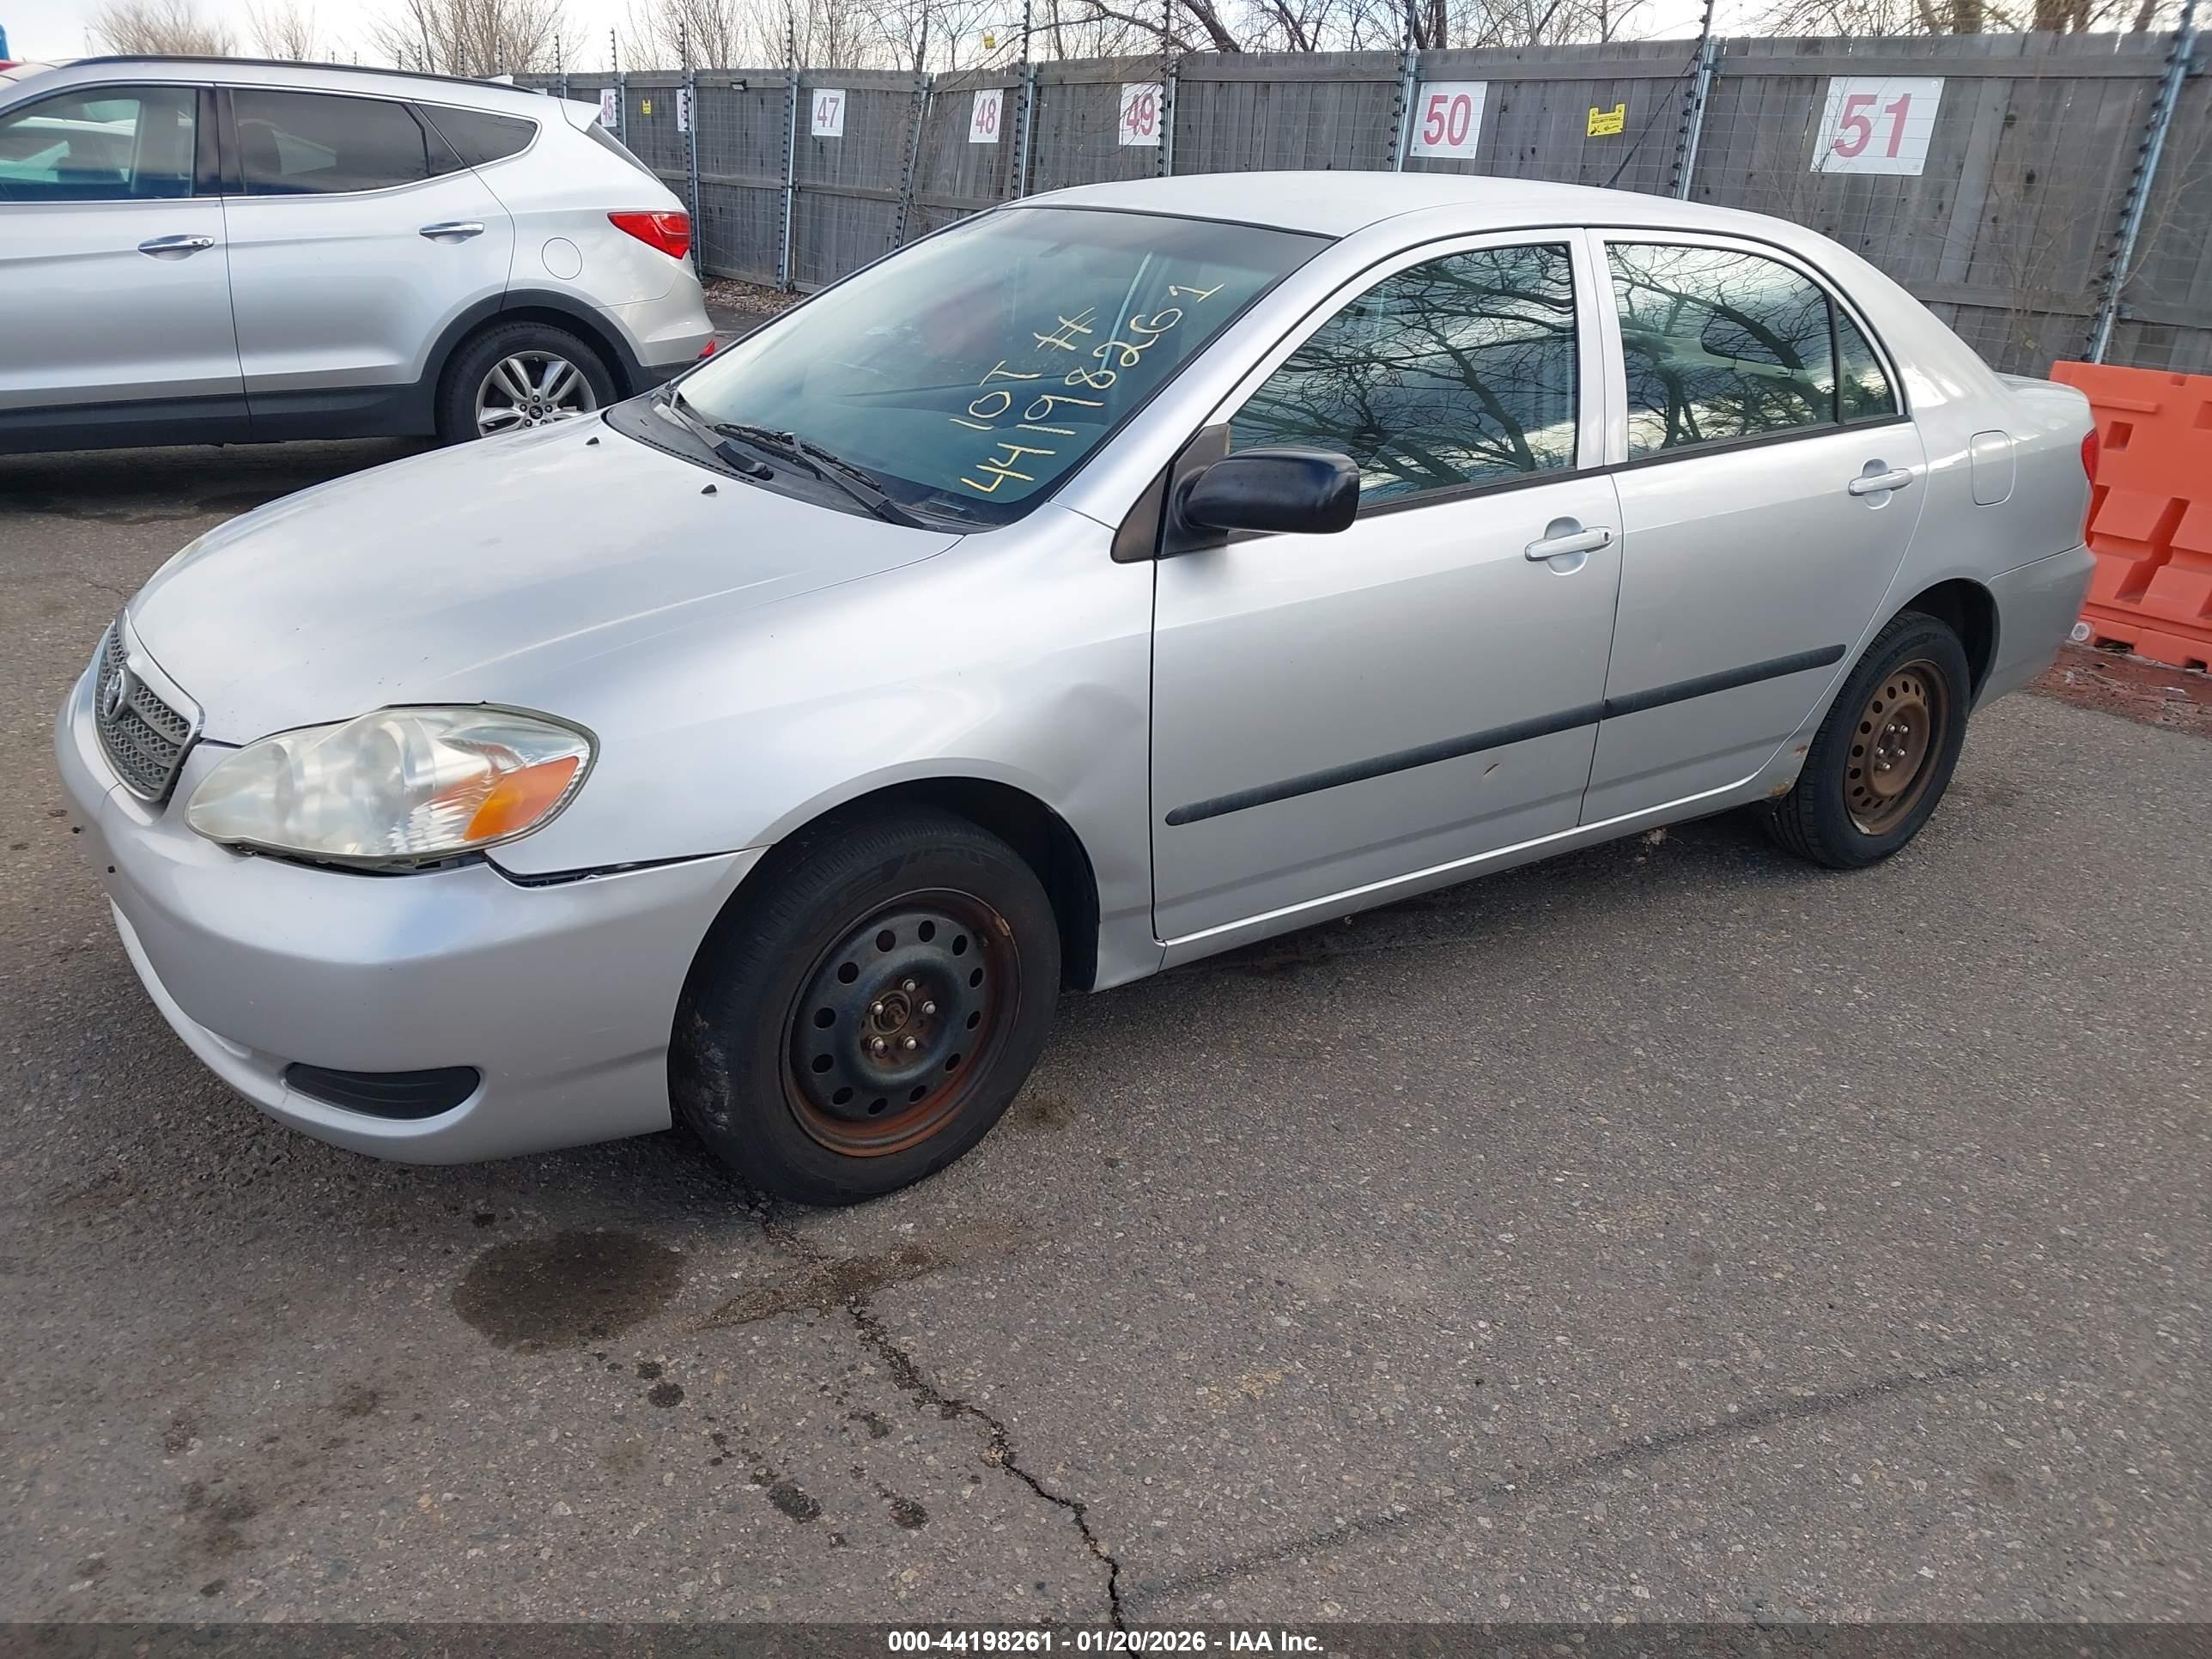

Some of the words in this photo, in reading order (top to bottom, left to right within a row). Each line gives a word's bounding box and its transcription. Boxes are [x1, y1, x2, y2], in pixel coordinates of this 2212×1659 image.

[817, 96, 840, 128] 47
[975, 98, 998, 135] 48
[1127, 94, 1156, 136] 49
[1423, 94, 1472, 146] 50
[1834, 94, 1911, 157] 51
[961, 283, 1225, 493] 44198261
